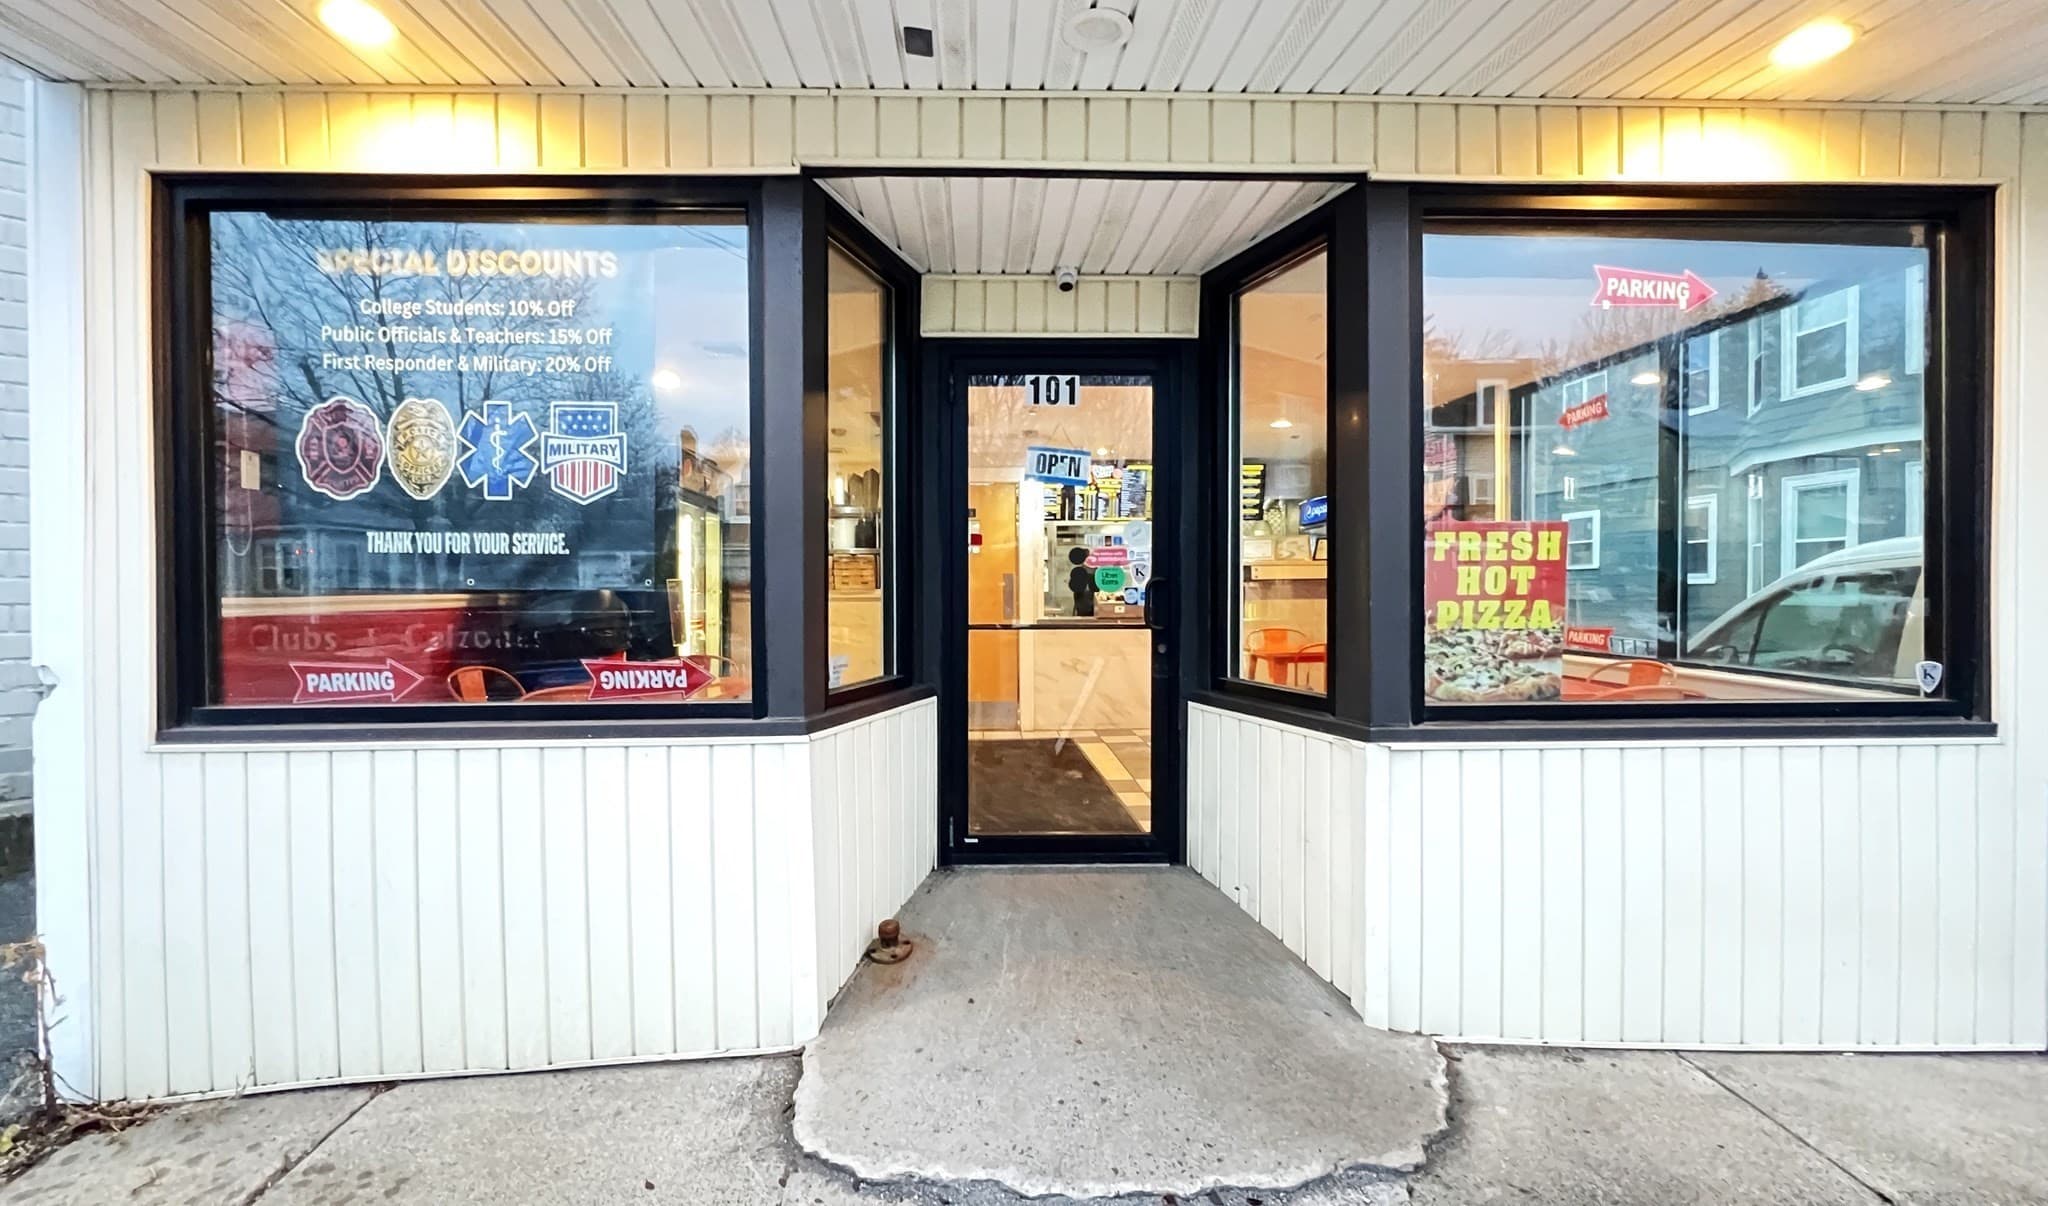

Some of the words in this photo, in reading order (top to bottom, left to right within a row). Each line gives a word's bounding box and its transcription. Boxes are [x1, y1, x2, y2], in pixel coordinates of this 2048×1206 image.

[447, 248, 619, 278] DISCOUNTS
[1607, 277, 1691, 300] PARKING
[360, 299, 420, 319] College
[428, 299, 504, 317] Students:
[509, 299, 543, 318] 10%
[547, 299, 576, 318] Off
[321, 327, 374, 344] Public
[380, 327, 446, 345] Officials
[450, 329, 461, 344] &
[466, 327, 544, 345] Teachers:
[549, 328, 583, 346] 15%
[586, 328, 613, 346] Off
[323, 354, 359, 371] First
[365, 354, 454, 374] Responder
[457, 356, 469, 371] &
[473, 355, 542, 376] Military:
[545, 356, 581, 374] 20%
[584, 356, 612, 374] Off
[1029, 376, 1076, 406] 101
[1566, 401, 1603, 425] PARKING
[548, 443, 618, 458] MILITARY
[366, 531, 414, 554] THANK
[415, 531, 443, 554] YOU
[444, 531, 471, 554] FOR
[473, 531, 510, 555] YOUR
[512, 532, 570, 555] SERVICE.
[1433, 531, 1563, 562] FRESH
[1456, 565, 1537, 596] HOT
[1436, 600, 1552, 630] PIZZA
[252, 624, 337, 650] Clubs
[1568, 630, 1606, 646] PARKING
[306, 671, 396, 693] PARKING
[600, 668, 688, 690] PARKING
